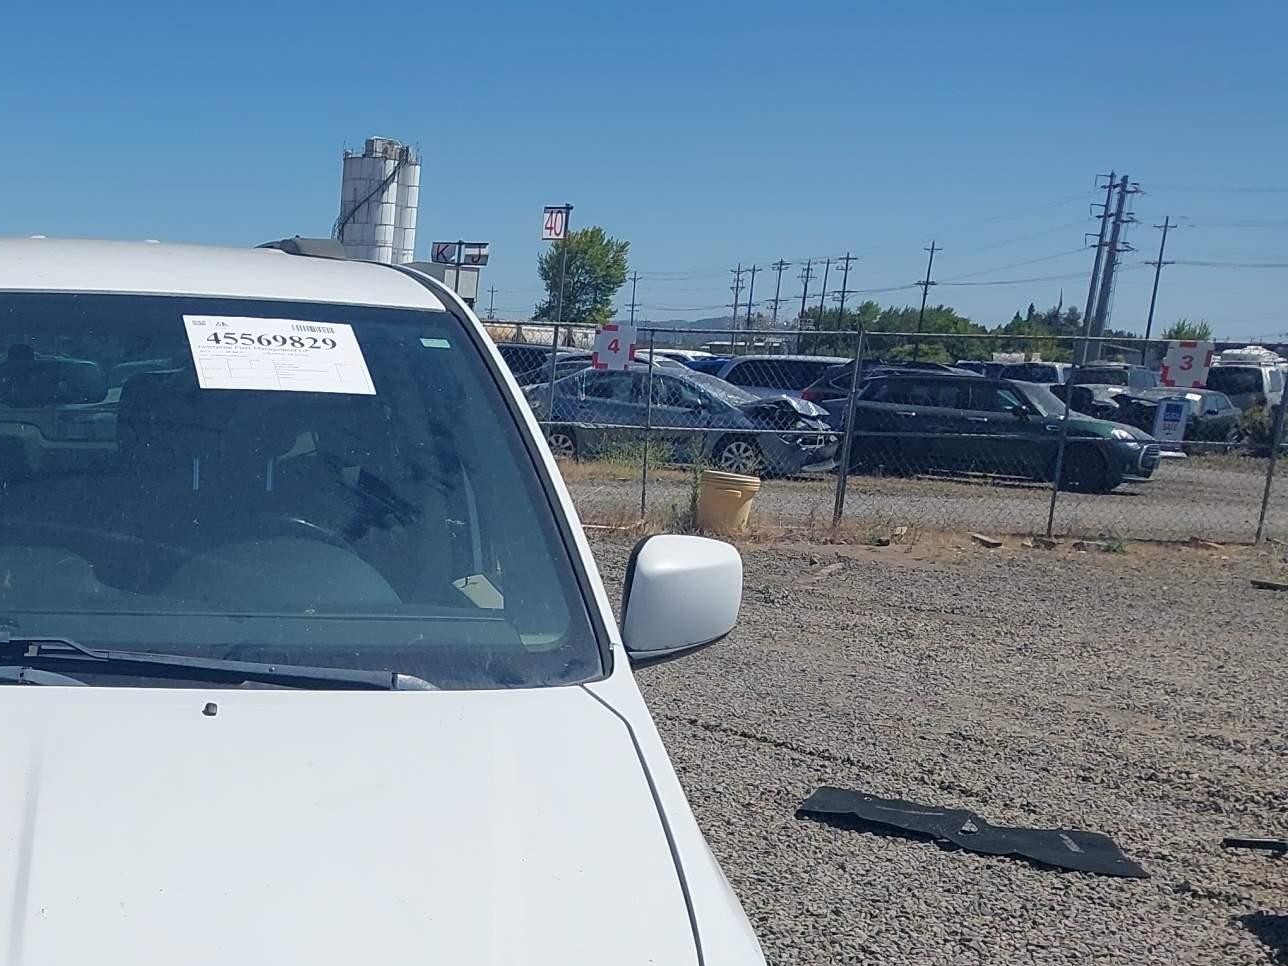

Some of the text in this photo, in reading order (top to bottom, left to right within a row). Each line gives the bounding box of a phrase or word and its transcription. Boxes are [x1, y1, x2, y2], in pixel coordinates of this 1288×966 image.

[545, 210, 563, 237] 40
[436, 244, 449, 261] K
[472, 244, 481, 263] J
[206, 331, 337, 350] 45569829
[607, 339, 620, 354] 4
[1179, 355, 1194, 371] 3
